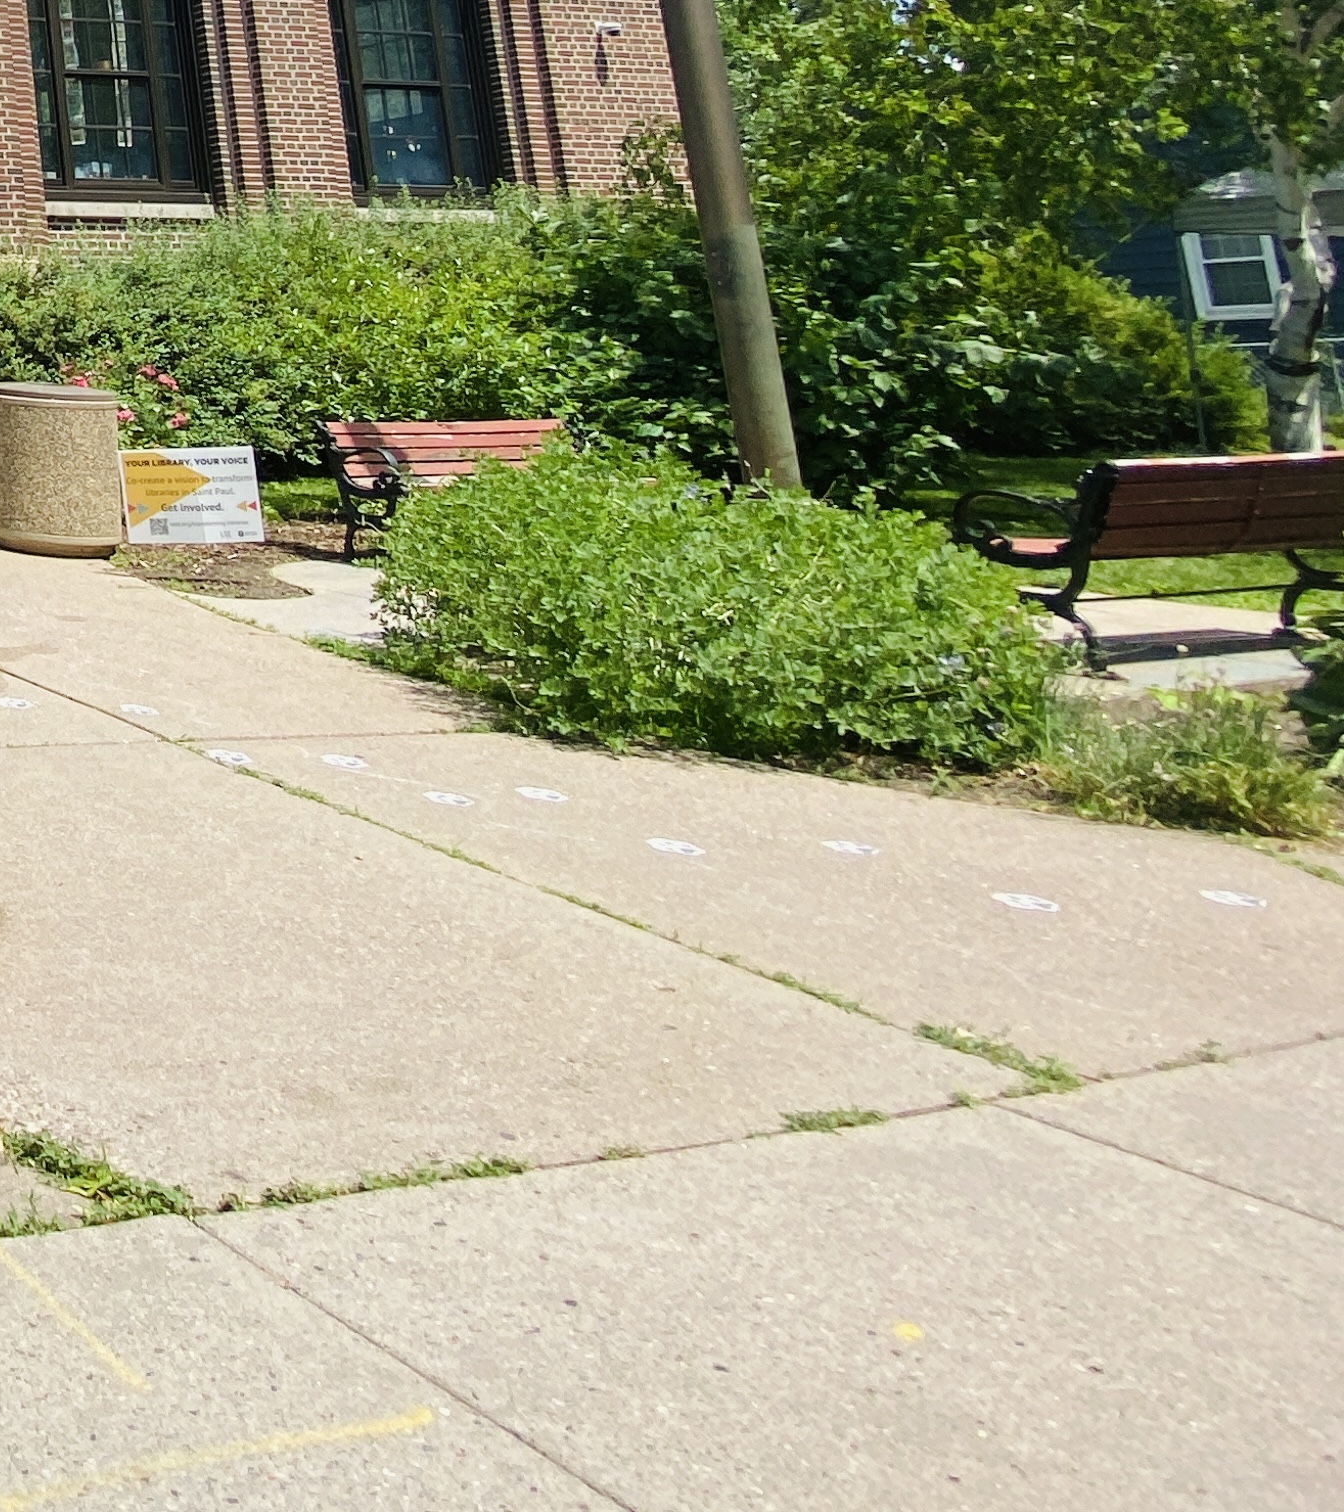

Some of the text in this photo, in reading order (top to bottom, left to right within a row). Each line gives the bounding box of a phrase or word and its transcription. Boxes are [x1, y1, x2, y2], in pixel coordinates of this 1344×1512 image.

[125, 460, 151, 468] YOUR
[151, 458, 194, 468] LIBRARY,
[193, 458, 220, 467] YOUR
[125, 477, 166, 485] Co-create
[174, 476, 200, 485] vision
[201, 475, 210, 484] to
[211, 474, 253, 483] transform
[181, 488, 190, 497] in
[192, 488, 213, 497] Saint
[214, 487, 236, 496] Paul.
[160, 502, 225, 512] Get involved.
